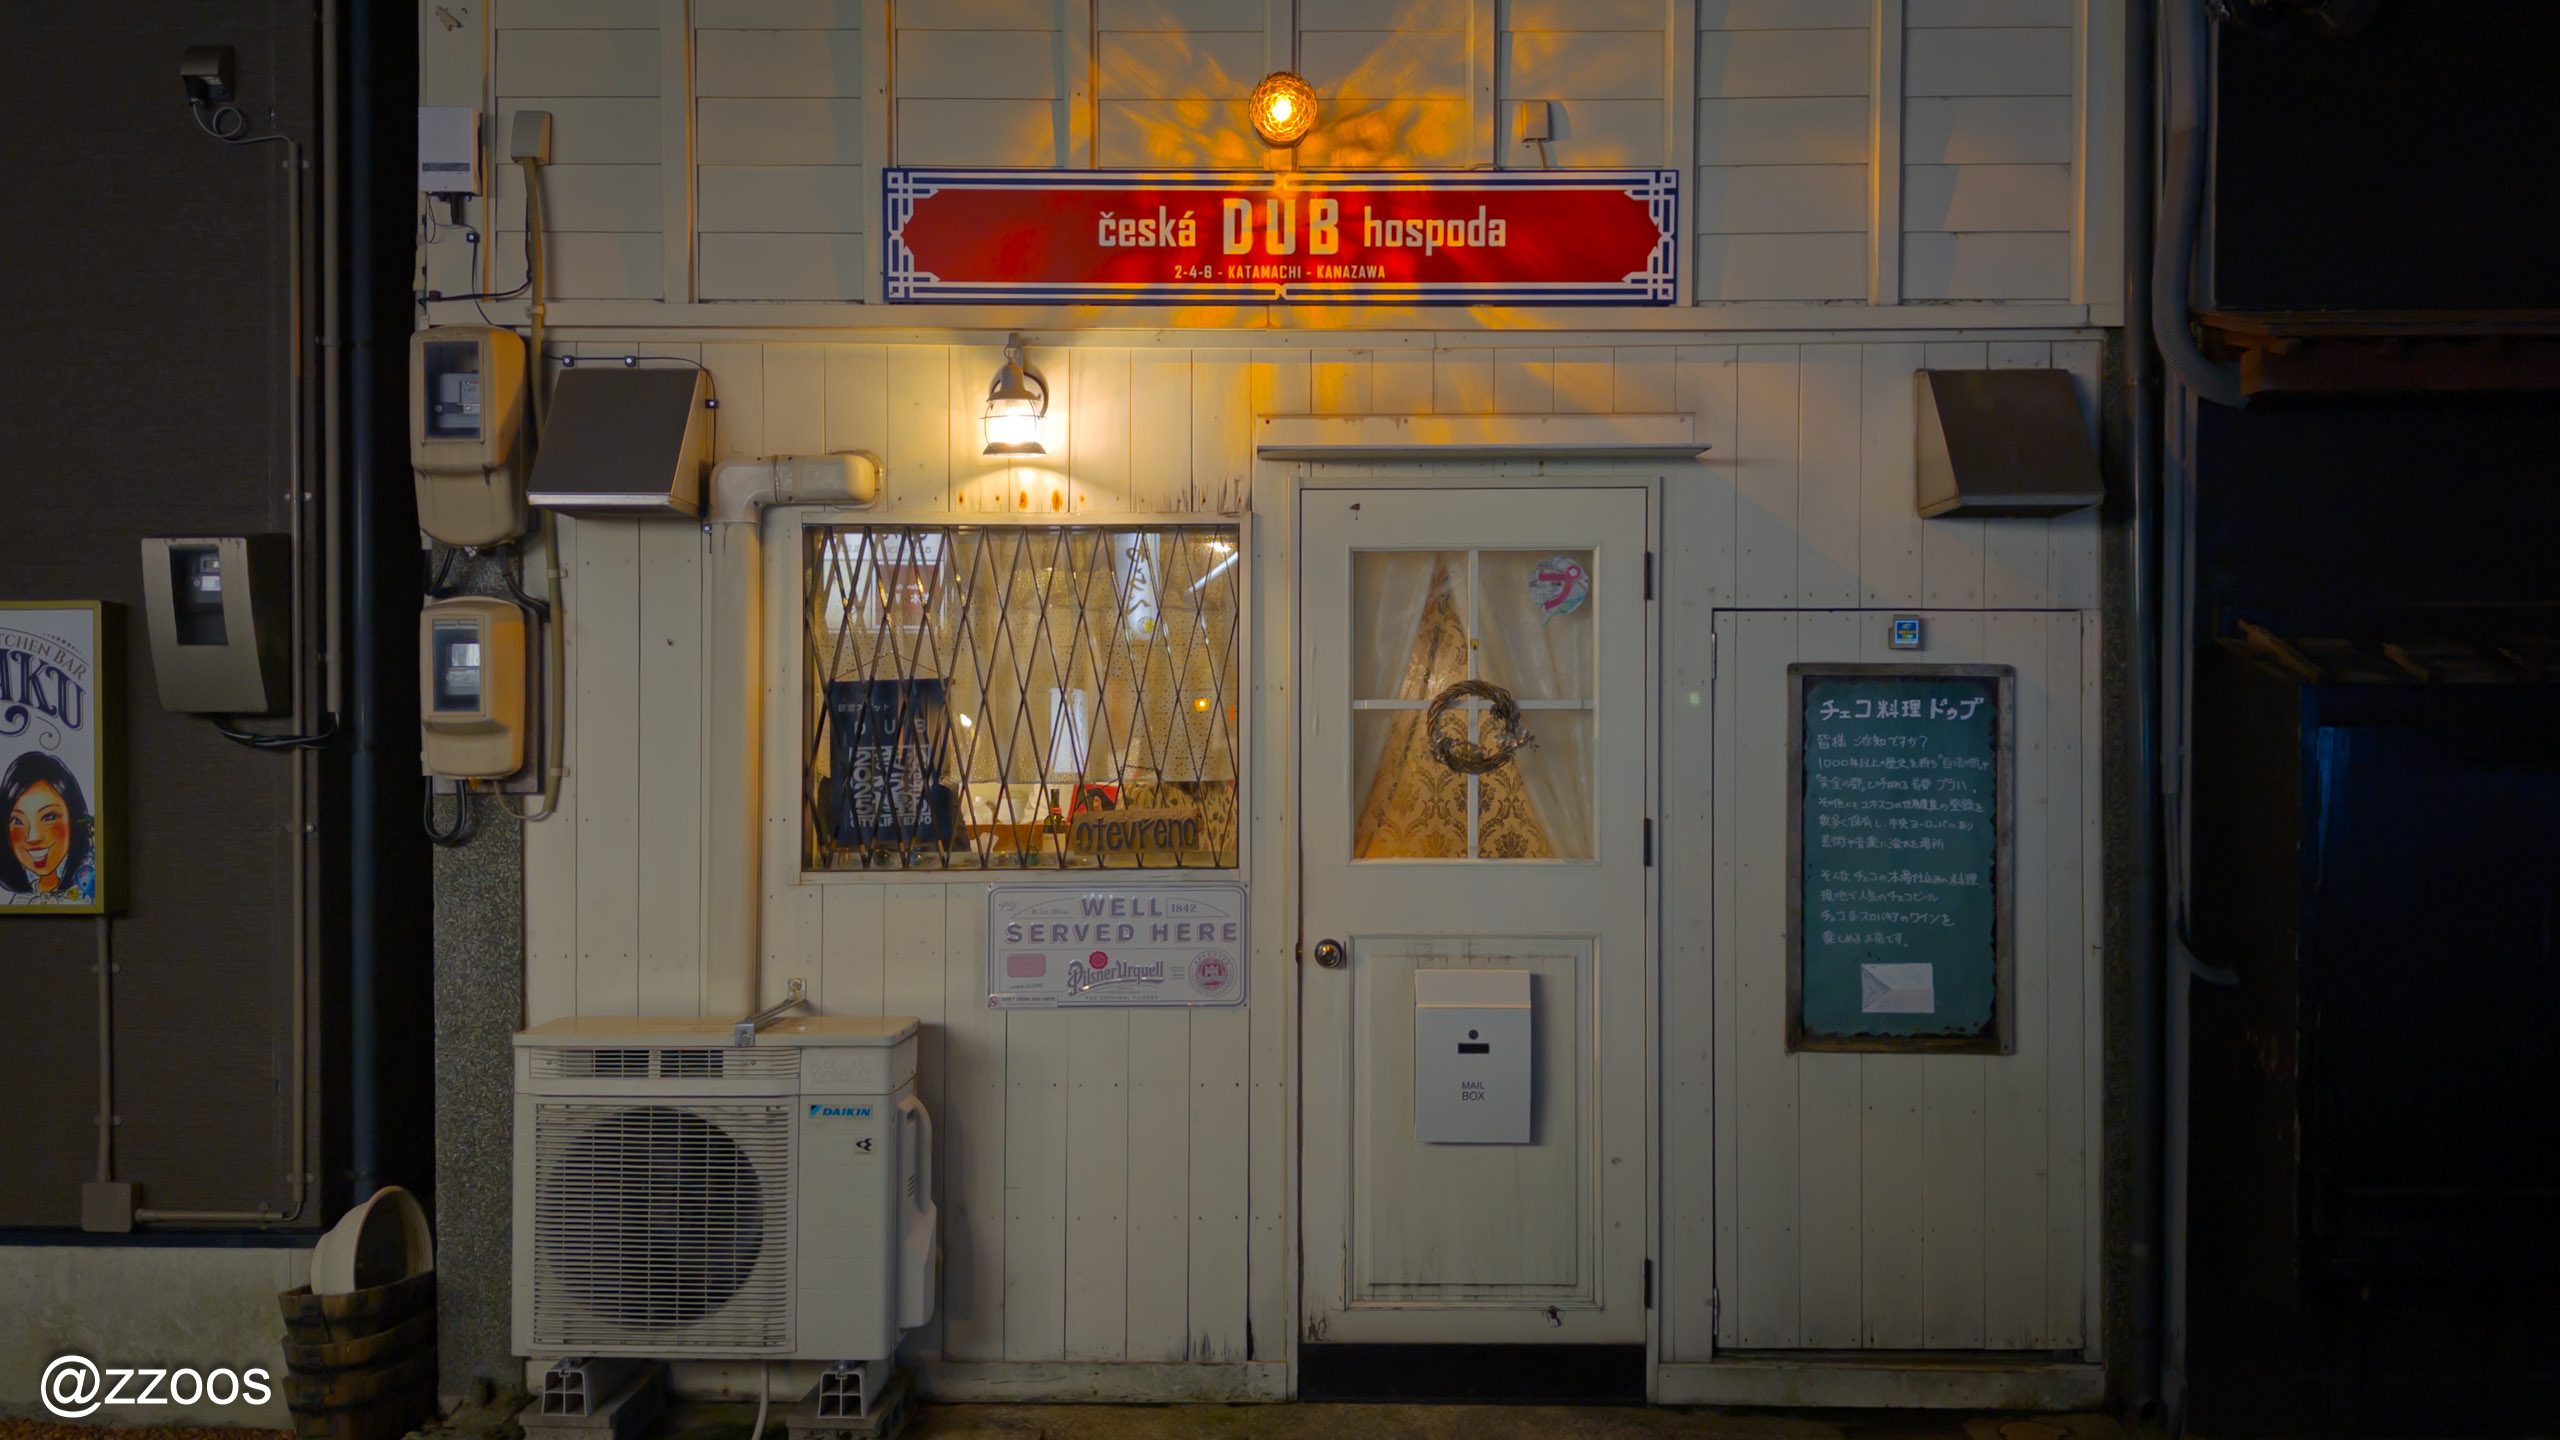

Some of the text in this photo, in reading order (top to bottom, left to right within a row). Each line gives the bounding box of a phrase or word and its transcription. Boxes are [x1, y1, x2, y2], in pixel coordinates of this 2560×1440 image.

[1098, 198, 1506, 256] česká DUB hospoda
[1228, 264, 1301, 279] KATAMACHI
[1316, 264, 1386, 279] KANAZAWA
[53, 648, 87, 680] BAR
[1819, 698, 1922, 721] チェコ料理
[1080, 895, 1163, 918] WELL
[1004, 922, 1238, 944] SERVED HERE
[1066, 958, 1164, 996] Pilsner Urquell
[1461, 1081, 1486, 1090] MAIL
[1461, 1091, 1486, 1101] BOX
[822, 1107, 872, 1118] DAIKIN
